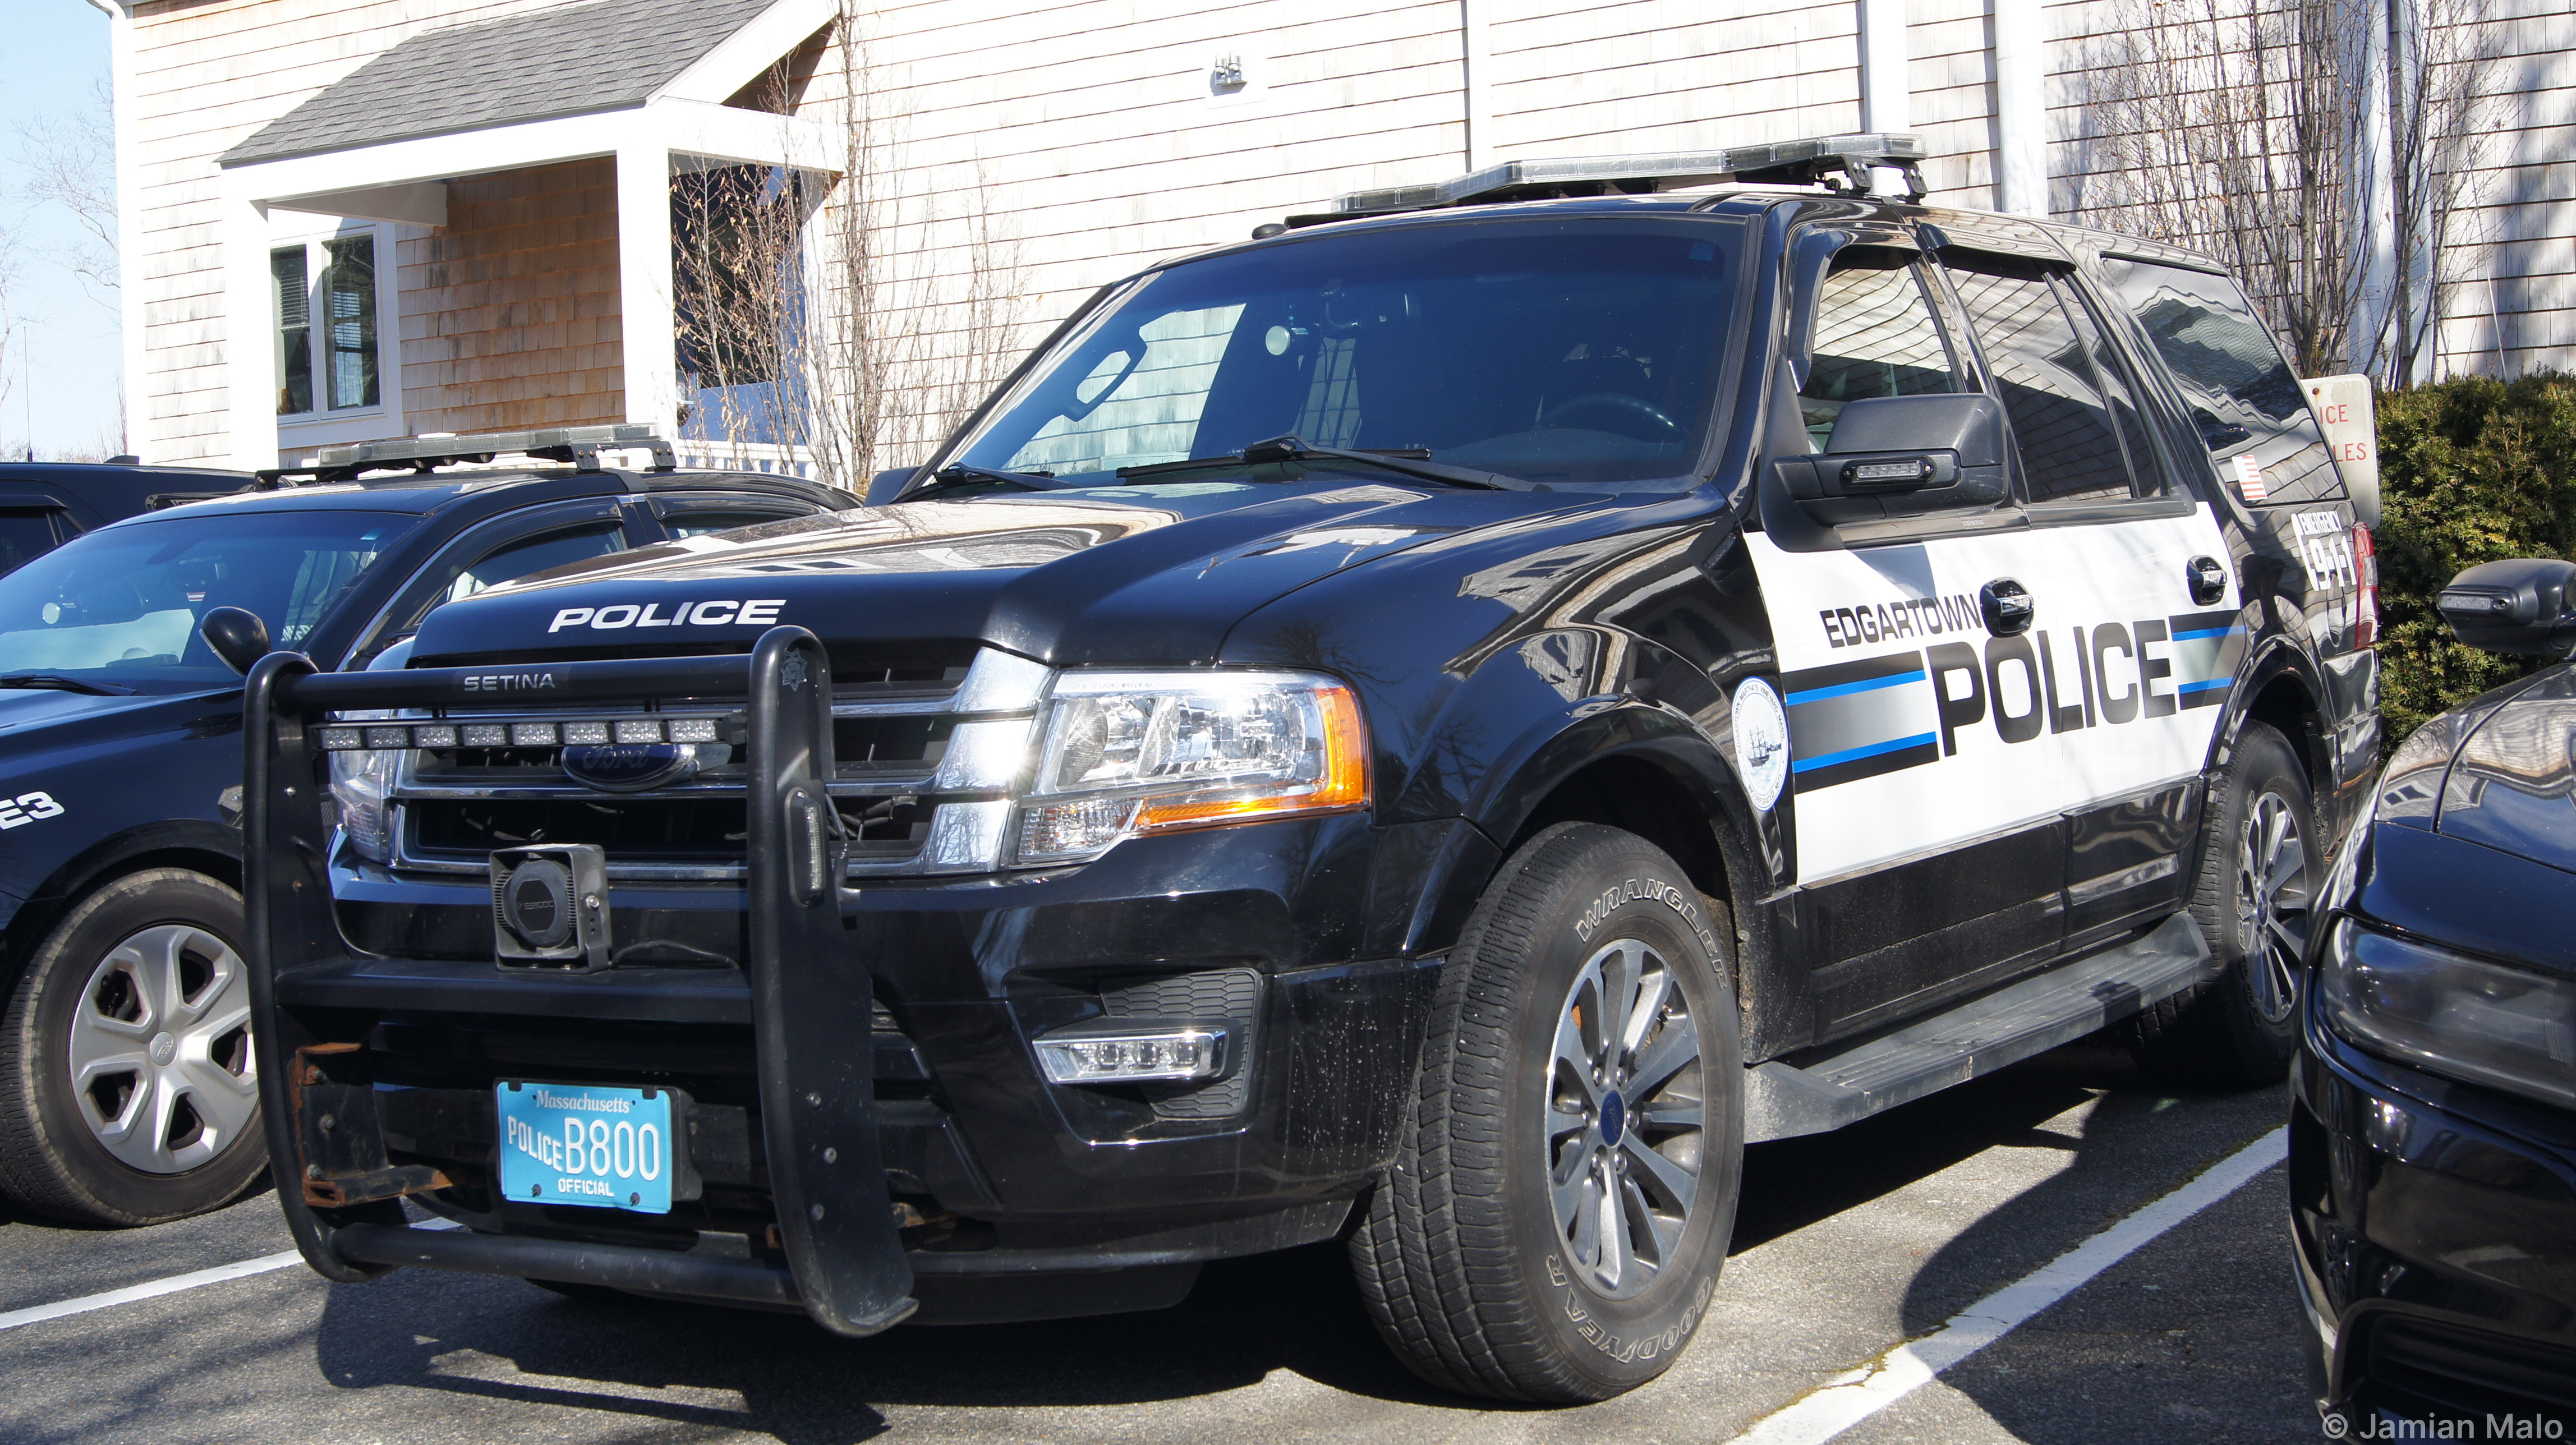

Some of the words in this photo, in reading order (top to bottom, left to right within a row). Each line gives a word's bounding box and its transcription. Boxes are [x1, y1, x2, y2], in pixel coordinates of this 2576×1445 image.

[2319, 404, 2349, 425] ICE
[2332, 442, 2367, 462] LES
[2298, 510, 2343, 536] EMERGENCY
[2308, 535, 2357, 591] 9-1-1
[548, 599, 786, 633] POLICE
[1819, 593, 1983, 648] EDGARTOWN
[464, 673, 556, 692] SETINA
[1925, 619, 2177, 757] POLICE
[1575, 877, 1728, 991] WRANGLER
[536, 1090, 630, 1113] Massachusetts
[508, 1115, 563, 1173] POLICE
[564, 1117, 660, 1182] B800
[558, 1178, 615, 1197] OFFICIAL
[1545, 1253, 1711, 1364] GOODYEAR
